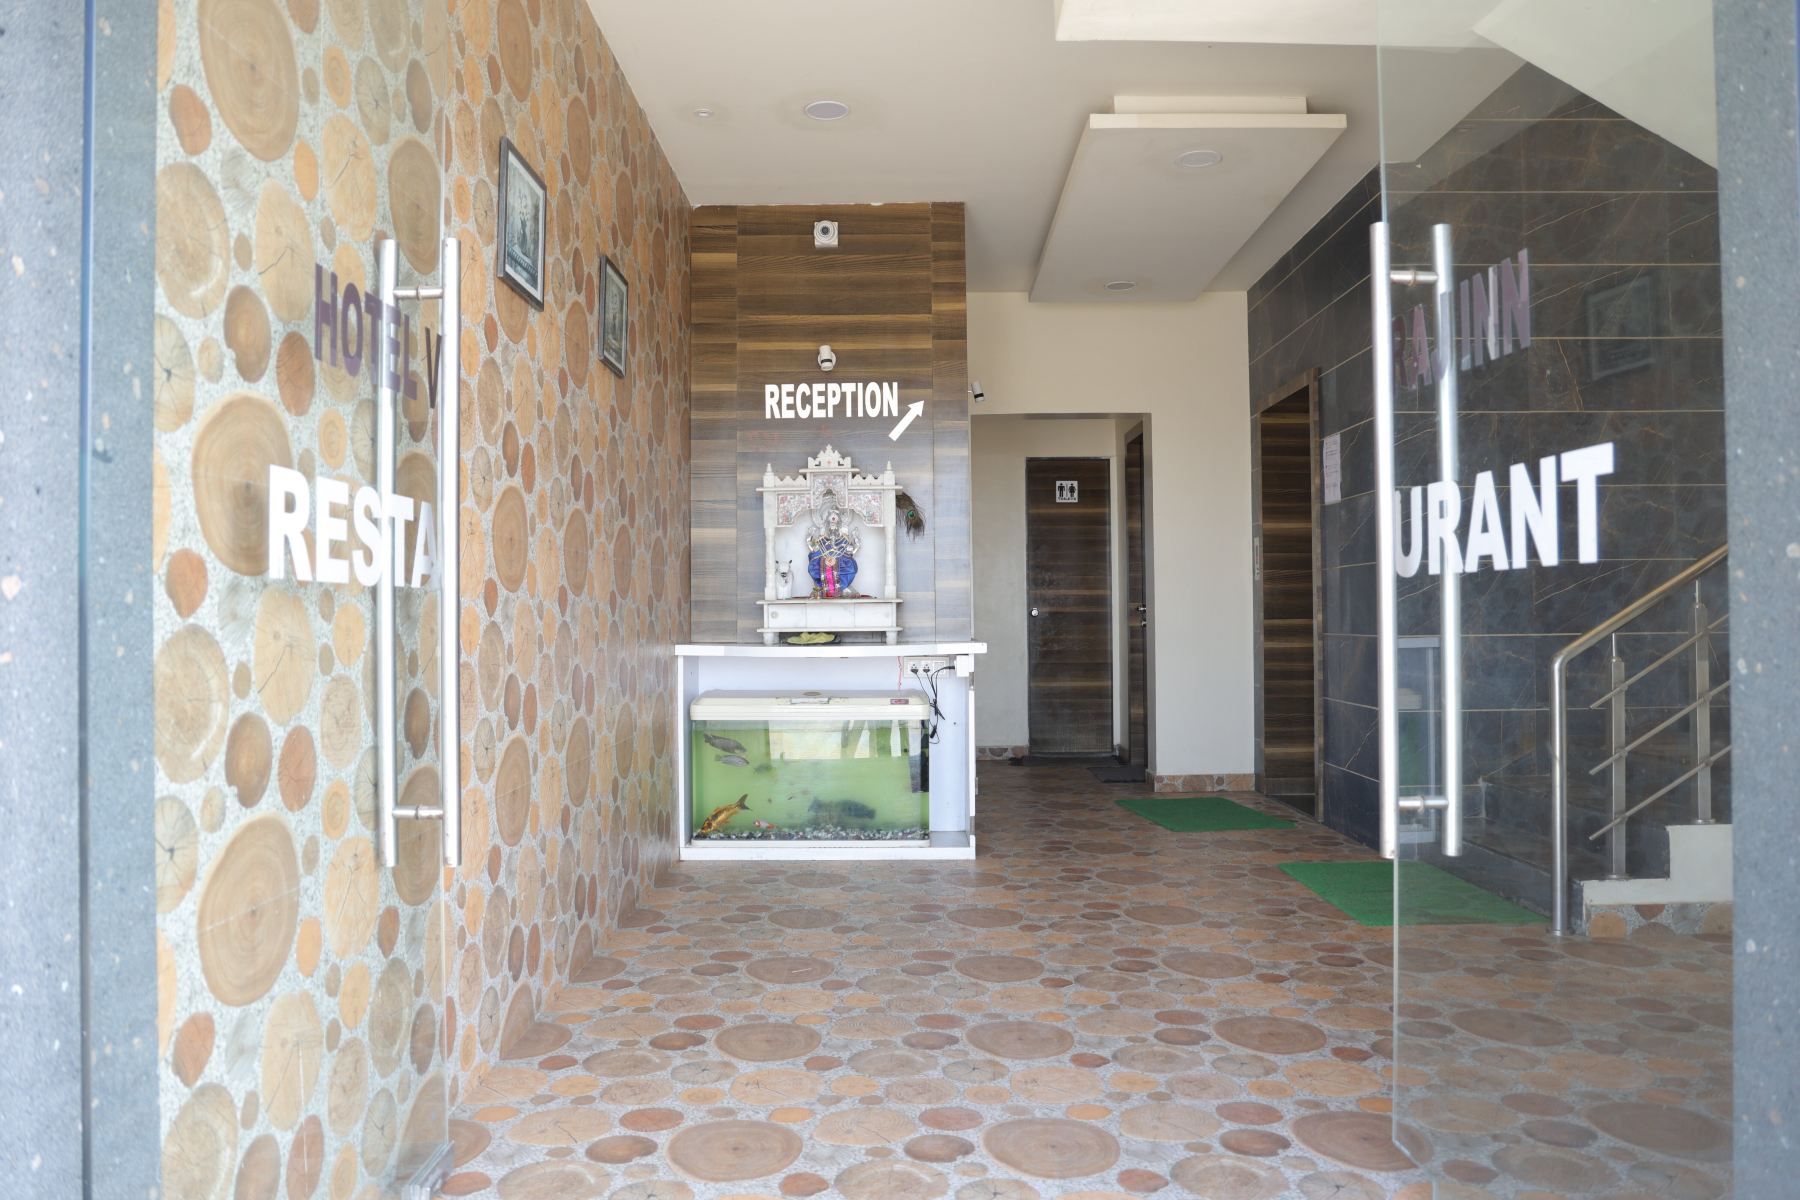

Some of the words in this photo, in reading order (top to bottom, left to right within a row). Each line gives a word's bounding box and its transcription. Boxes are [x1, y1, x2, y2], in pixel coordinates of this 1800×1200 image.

[314, 263, 417, 400] HOTEL
[1460, 247, 1531, 372] INN
[765, 382, 898, 419] RECEPTION
[269, 464, 440, 588] RESTA
[1394, 442, 1614, 578] URANT
